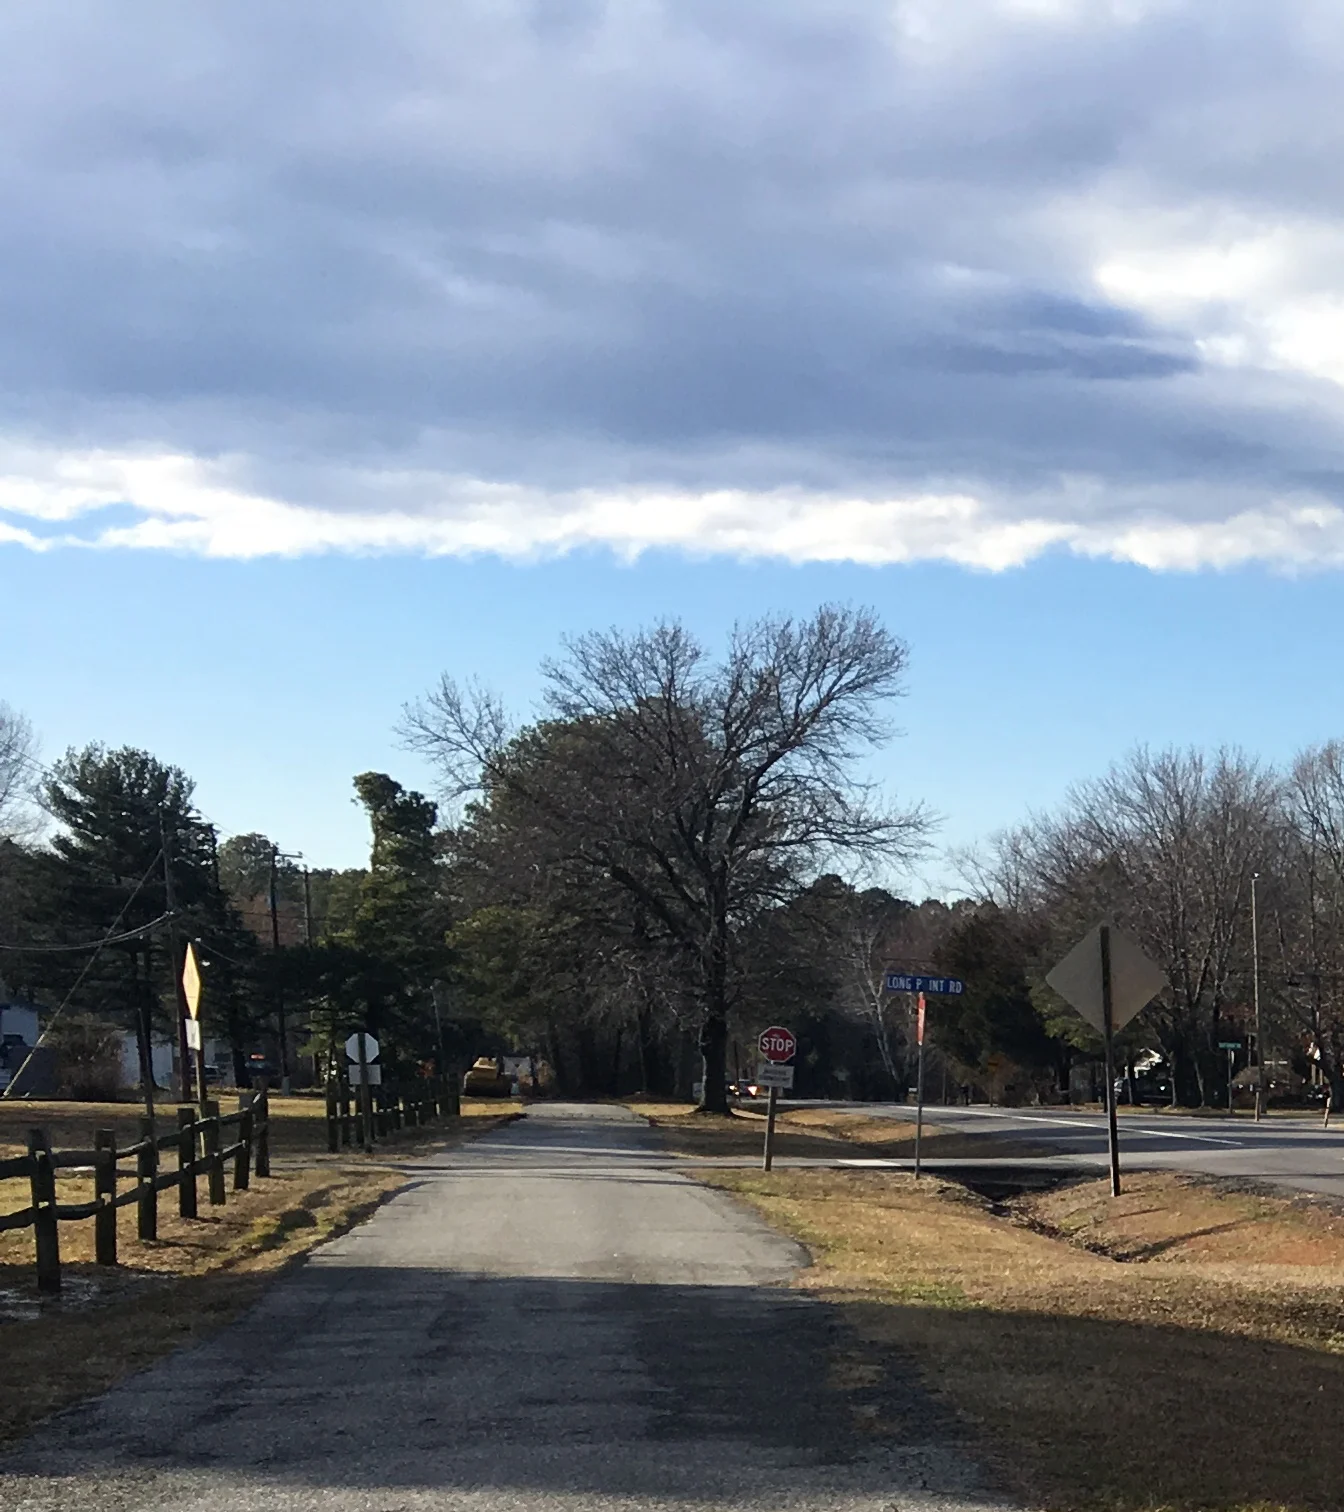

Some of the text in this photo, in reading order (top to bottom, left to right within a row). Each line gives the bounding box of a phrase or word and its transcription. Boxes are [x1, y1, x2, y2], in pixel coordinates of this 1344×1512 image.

[887, 976, 963, 994] LONG PINT RD
[762, 1037, 793, 1052] STOP
